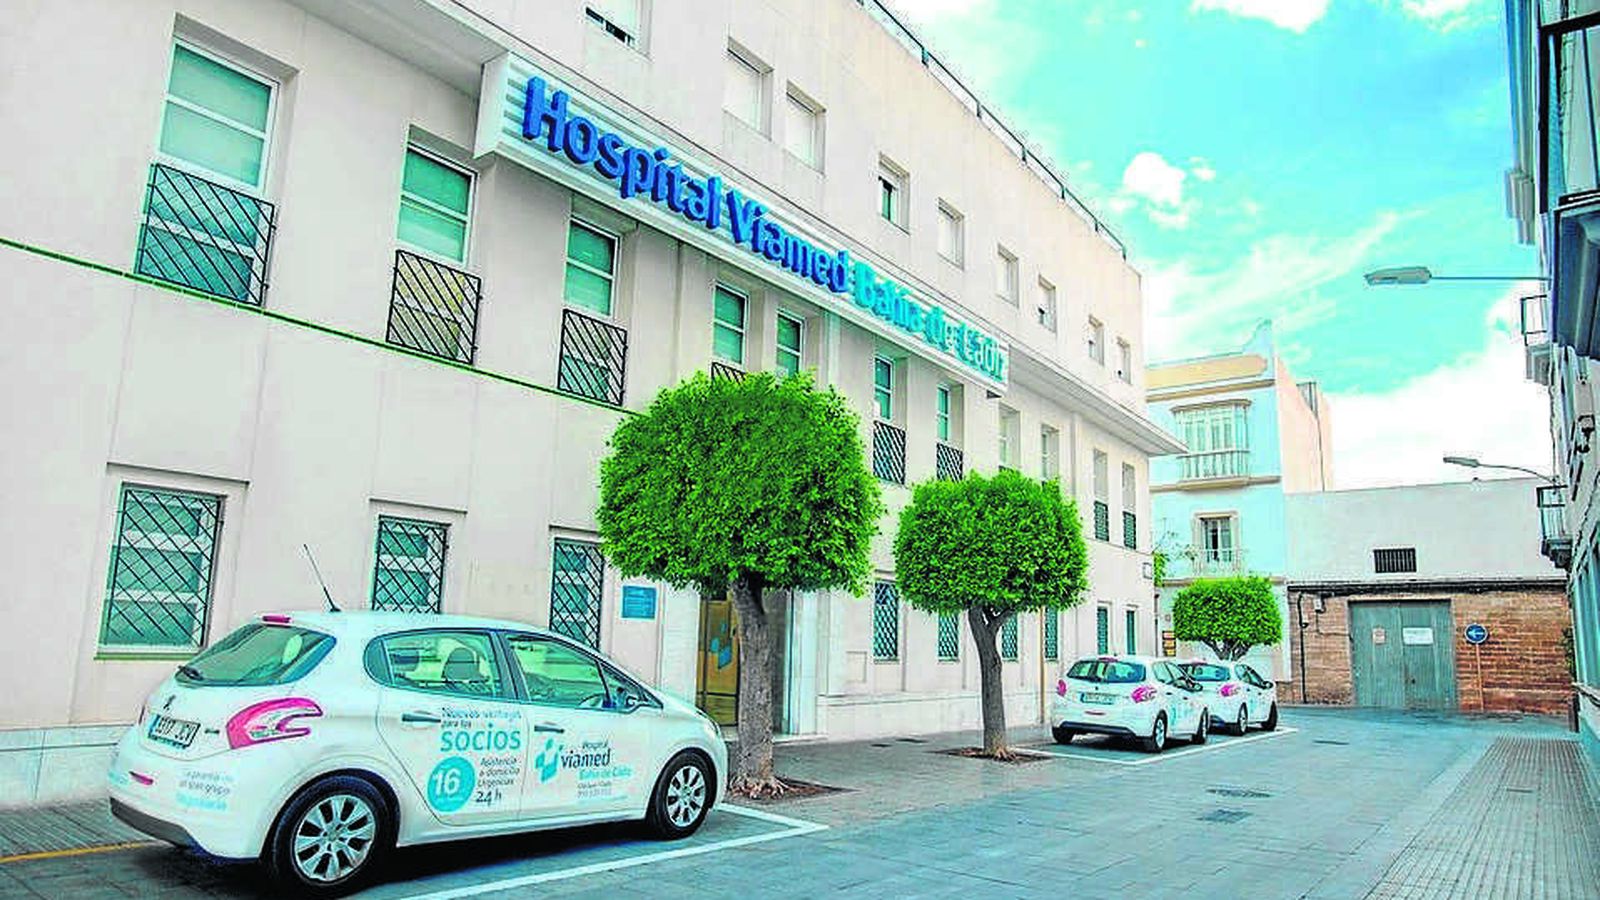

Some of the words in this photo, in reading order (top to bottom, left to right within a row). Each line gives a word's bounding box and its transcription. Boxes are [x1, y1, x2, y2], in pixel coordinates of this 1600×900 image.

[522, 76, 721, 228] Hospital
[726, 189, 849, 292] Viamed
[440, 722, 521, 752] socios
[561, 748, 611, 769] viamed
[432, 768, 461, 797] 16
[475, 790, 493, 807] 24
